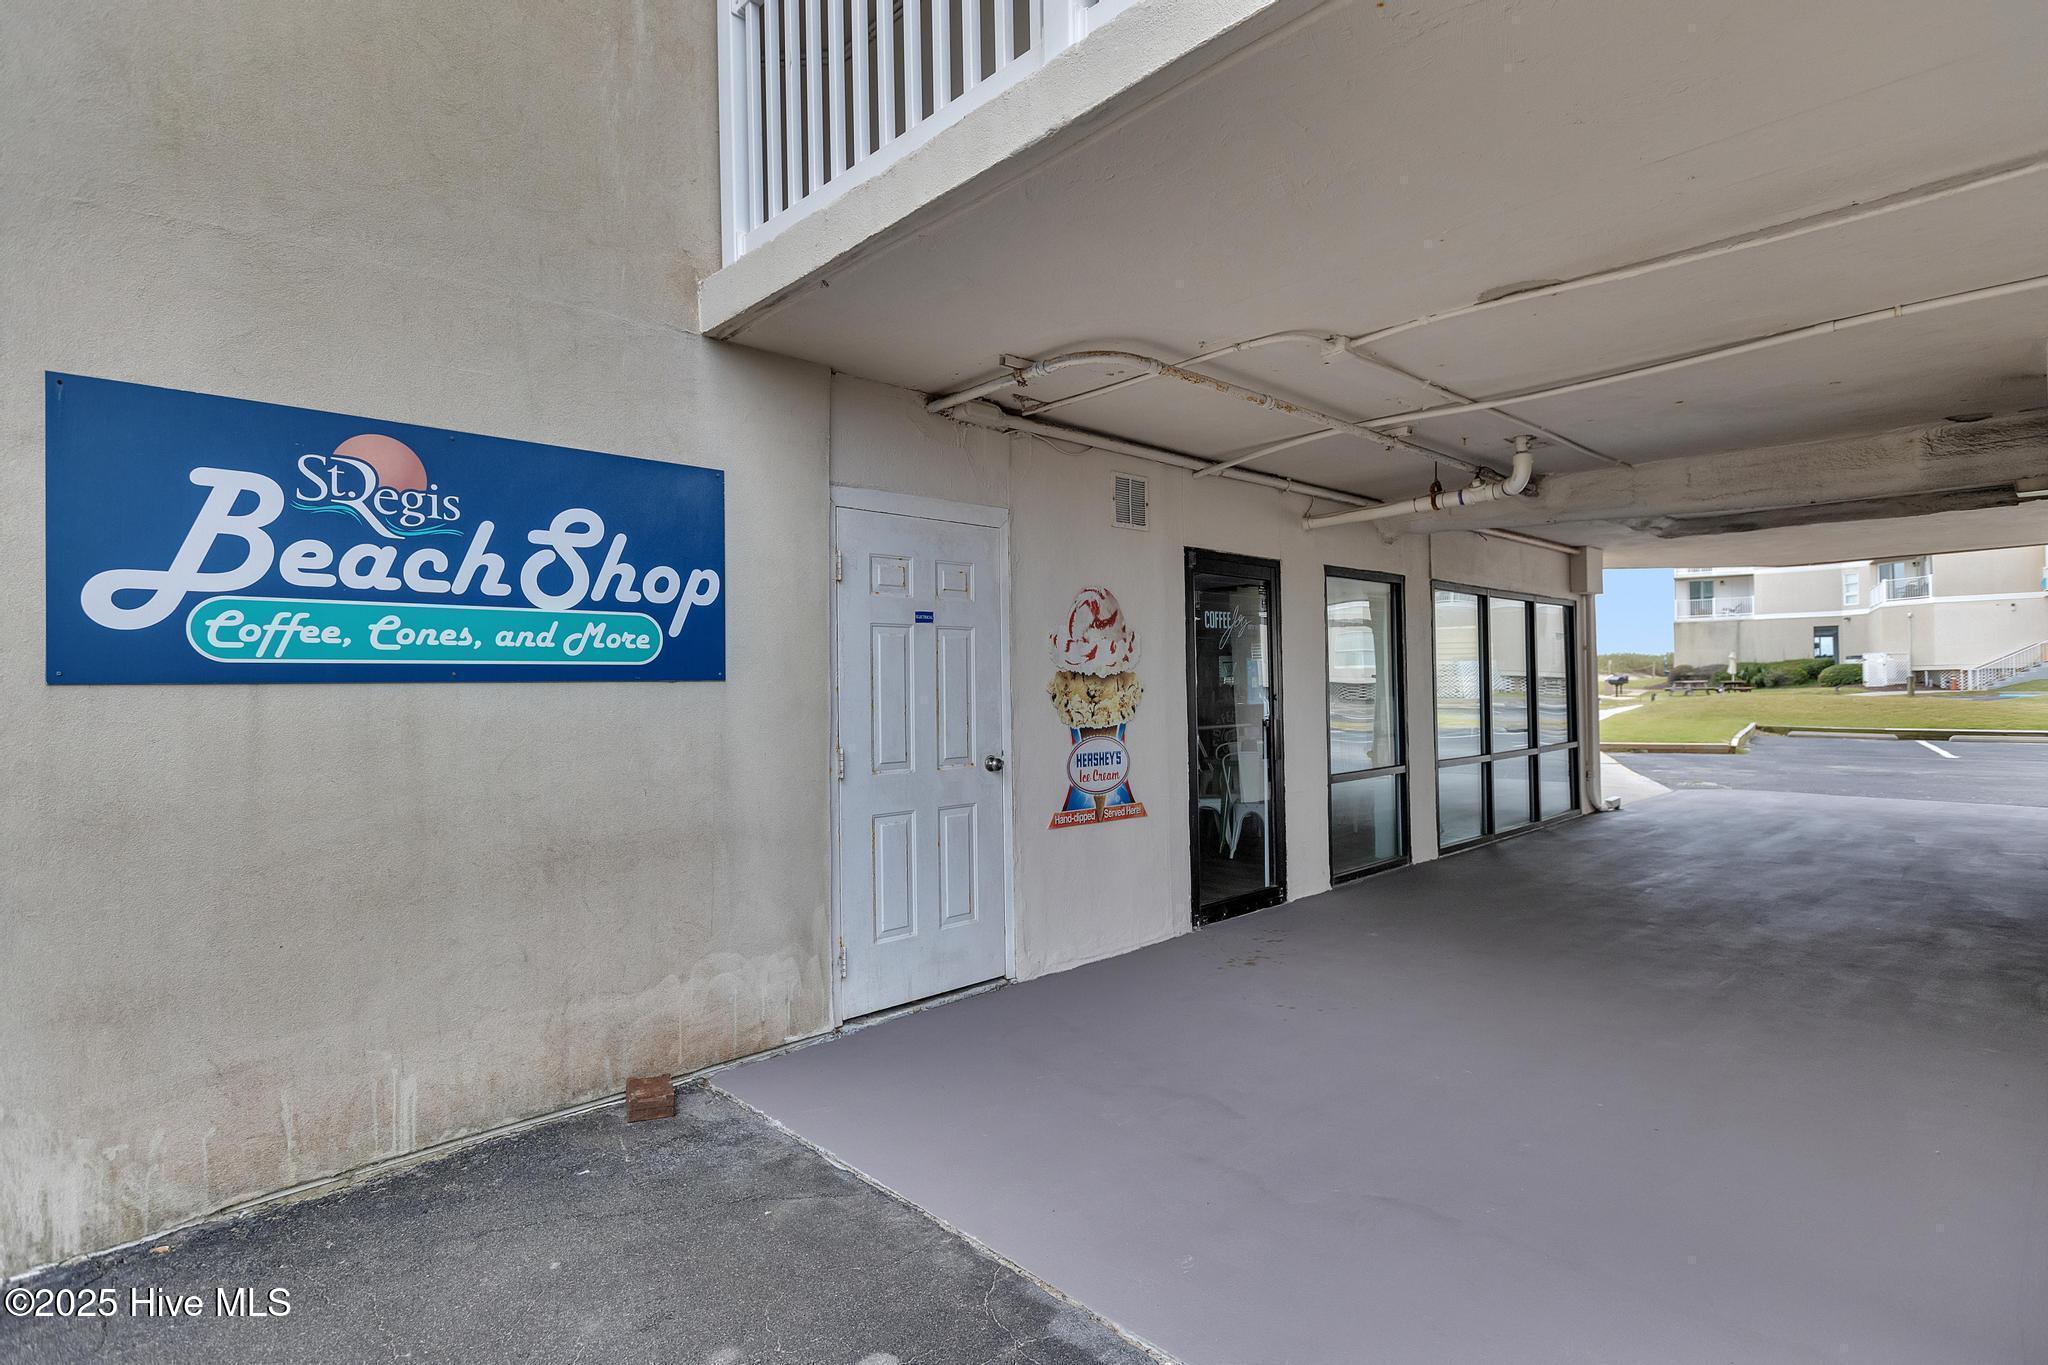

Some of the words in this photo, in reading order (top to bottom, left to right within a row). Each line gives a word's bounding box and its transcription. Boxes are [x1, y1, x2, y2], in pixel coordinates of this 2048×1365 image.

[330, 456, 462, 540] Regis
[81, 466, 512, 631] Beach
[520, 508, 720, 637] Shop
[1204, 610, 1232, 629] COFFEE
[204, 609, 352, 658] Coffee,
[368, 614, 482, 651] Cones,
[495, 621, 559, 648] and
[563, 621, 651, 656] More
[1076, 750, 1122, 768] HERSHEY'S
[1079, 769, 1091, 783] Ice
[1092, 769, 1120, 782] Cream
[1054, 810, 1096, 825] Hand-dipped
[1103, 804, 1126, 819] Served
